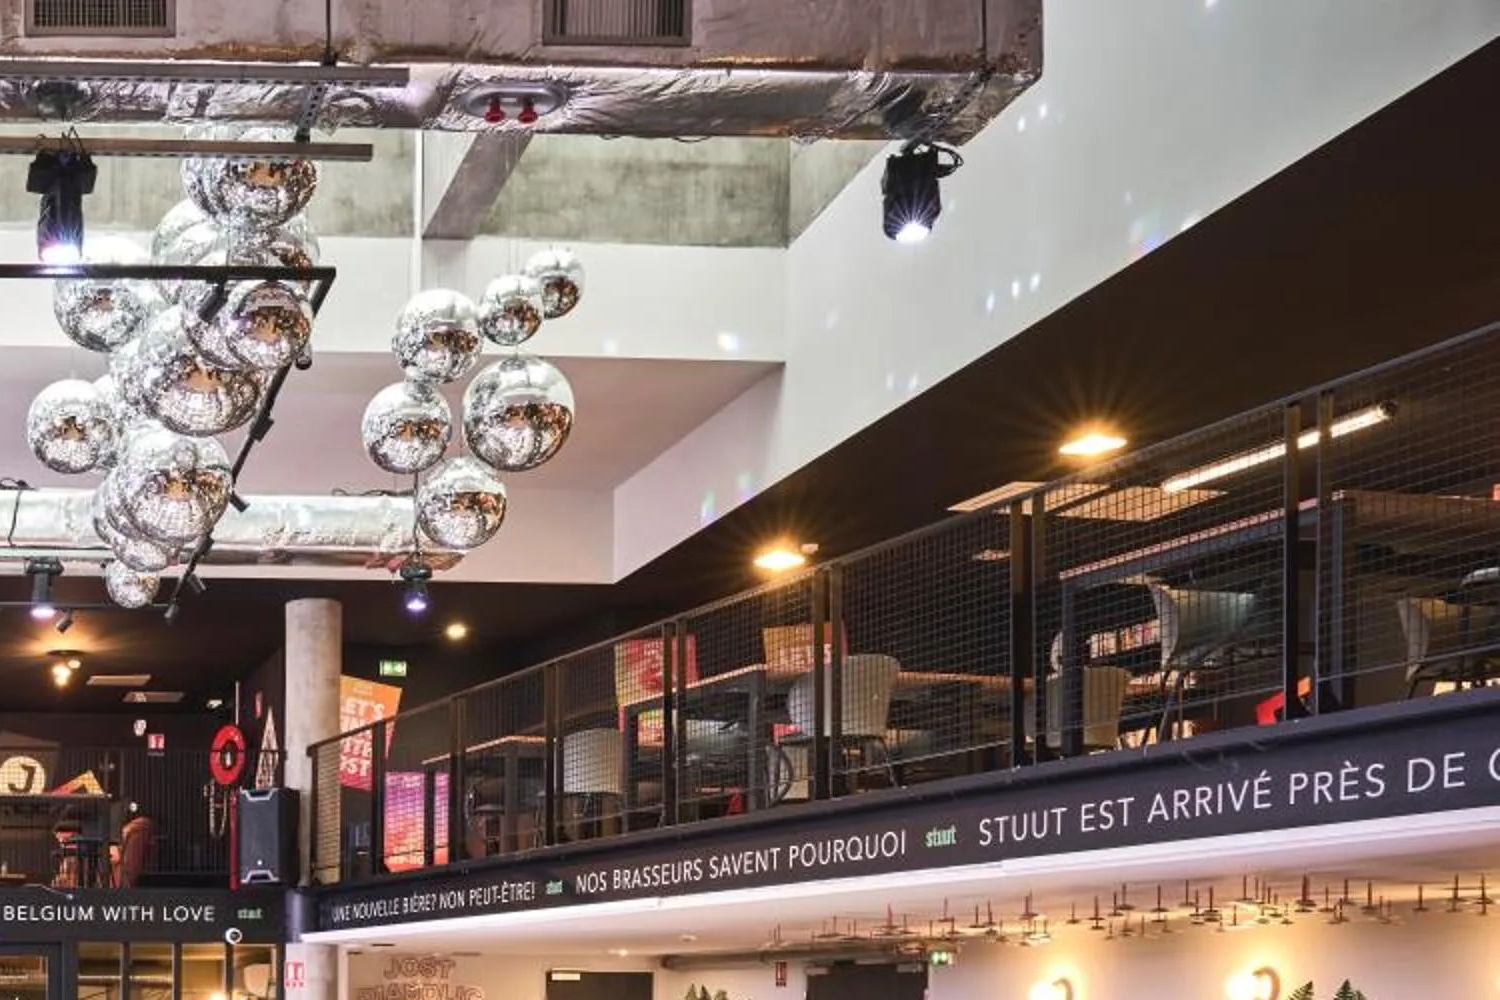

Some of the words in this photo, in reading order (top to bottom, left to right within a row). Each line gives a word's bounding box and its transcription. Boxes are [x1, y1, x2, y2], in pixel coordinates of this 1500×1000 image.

[979, 807, 1067, 846] STUUT
[1081, 797, 1135, 832] EST
[1147, 771, 1273, 823] ARRIVÉ
[1289, 760, 1385, 804] PRÈS
[1407, 752, 1466, 792] DE
[575, 870, 607, 895] NOS
[613, 858, 703, 890] BRASSEURS
[709, 847, 781, 879] SAVENT
[789, 830, 907, 869] POURQUOI
[3, 904, 94, 922] BELGIUM
[102, 904, 155, 922] WITH
[163, 904, 216, 922] LOVE
[332, 904, 351, 922] UNE
[353, 897, 399, 920] NOUVELLE
[439, 890, 465, 909] NON
